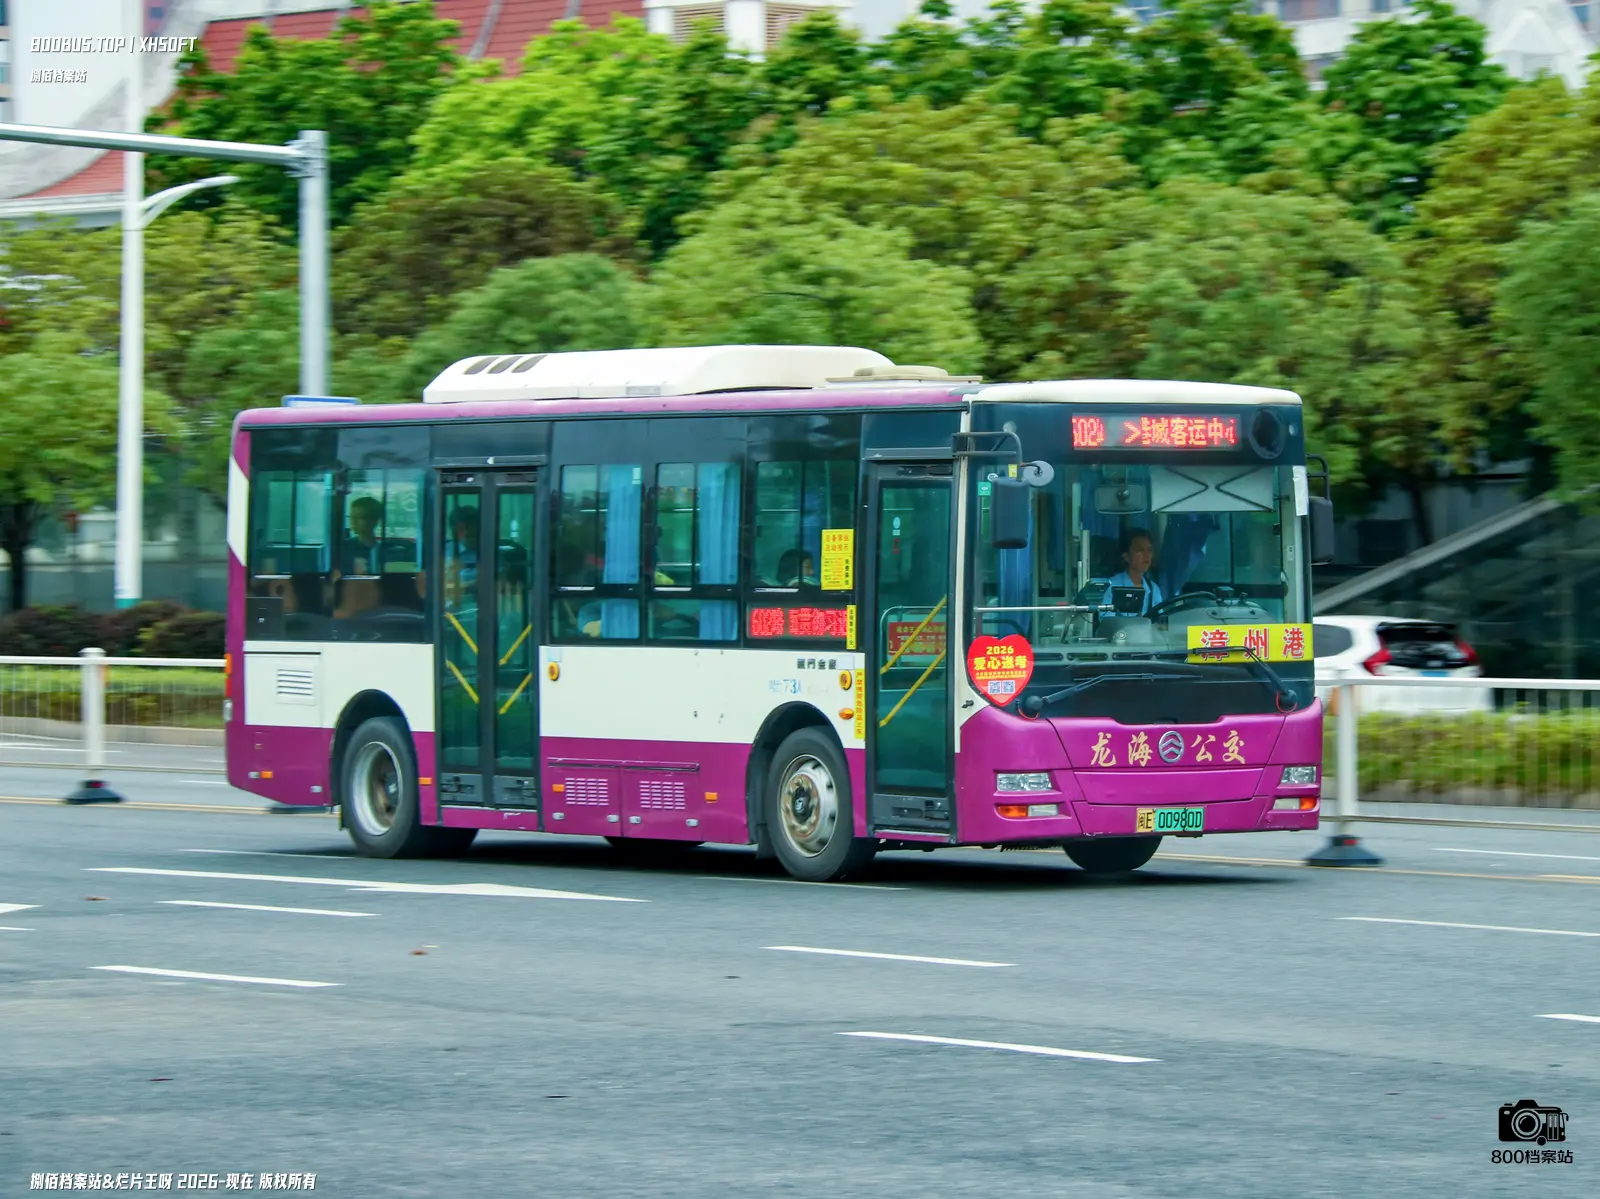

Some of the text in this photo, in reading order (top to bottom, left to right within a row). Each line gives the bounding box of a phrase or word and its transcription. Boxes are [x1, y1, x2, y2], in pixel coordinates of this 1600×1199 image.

[985, 645, 1015, 655] 2026
[1200, 627, 1305, 661] 漳州港
[973, 655, 1027, 671] 爱心送考
